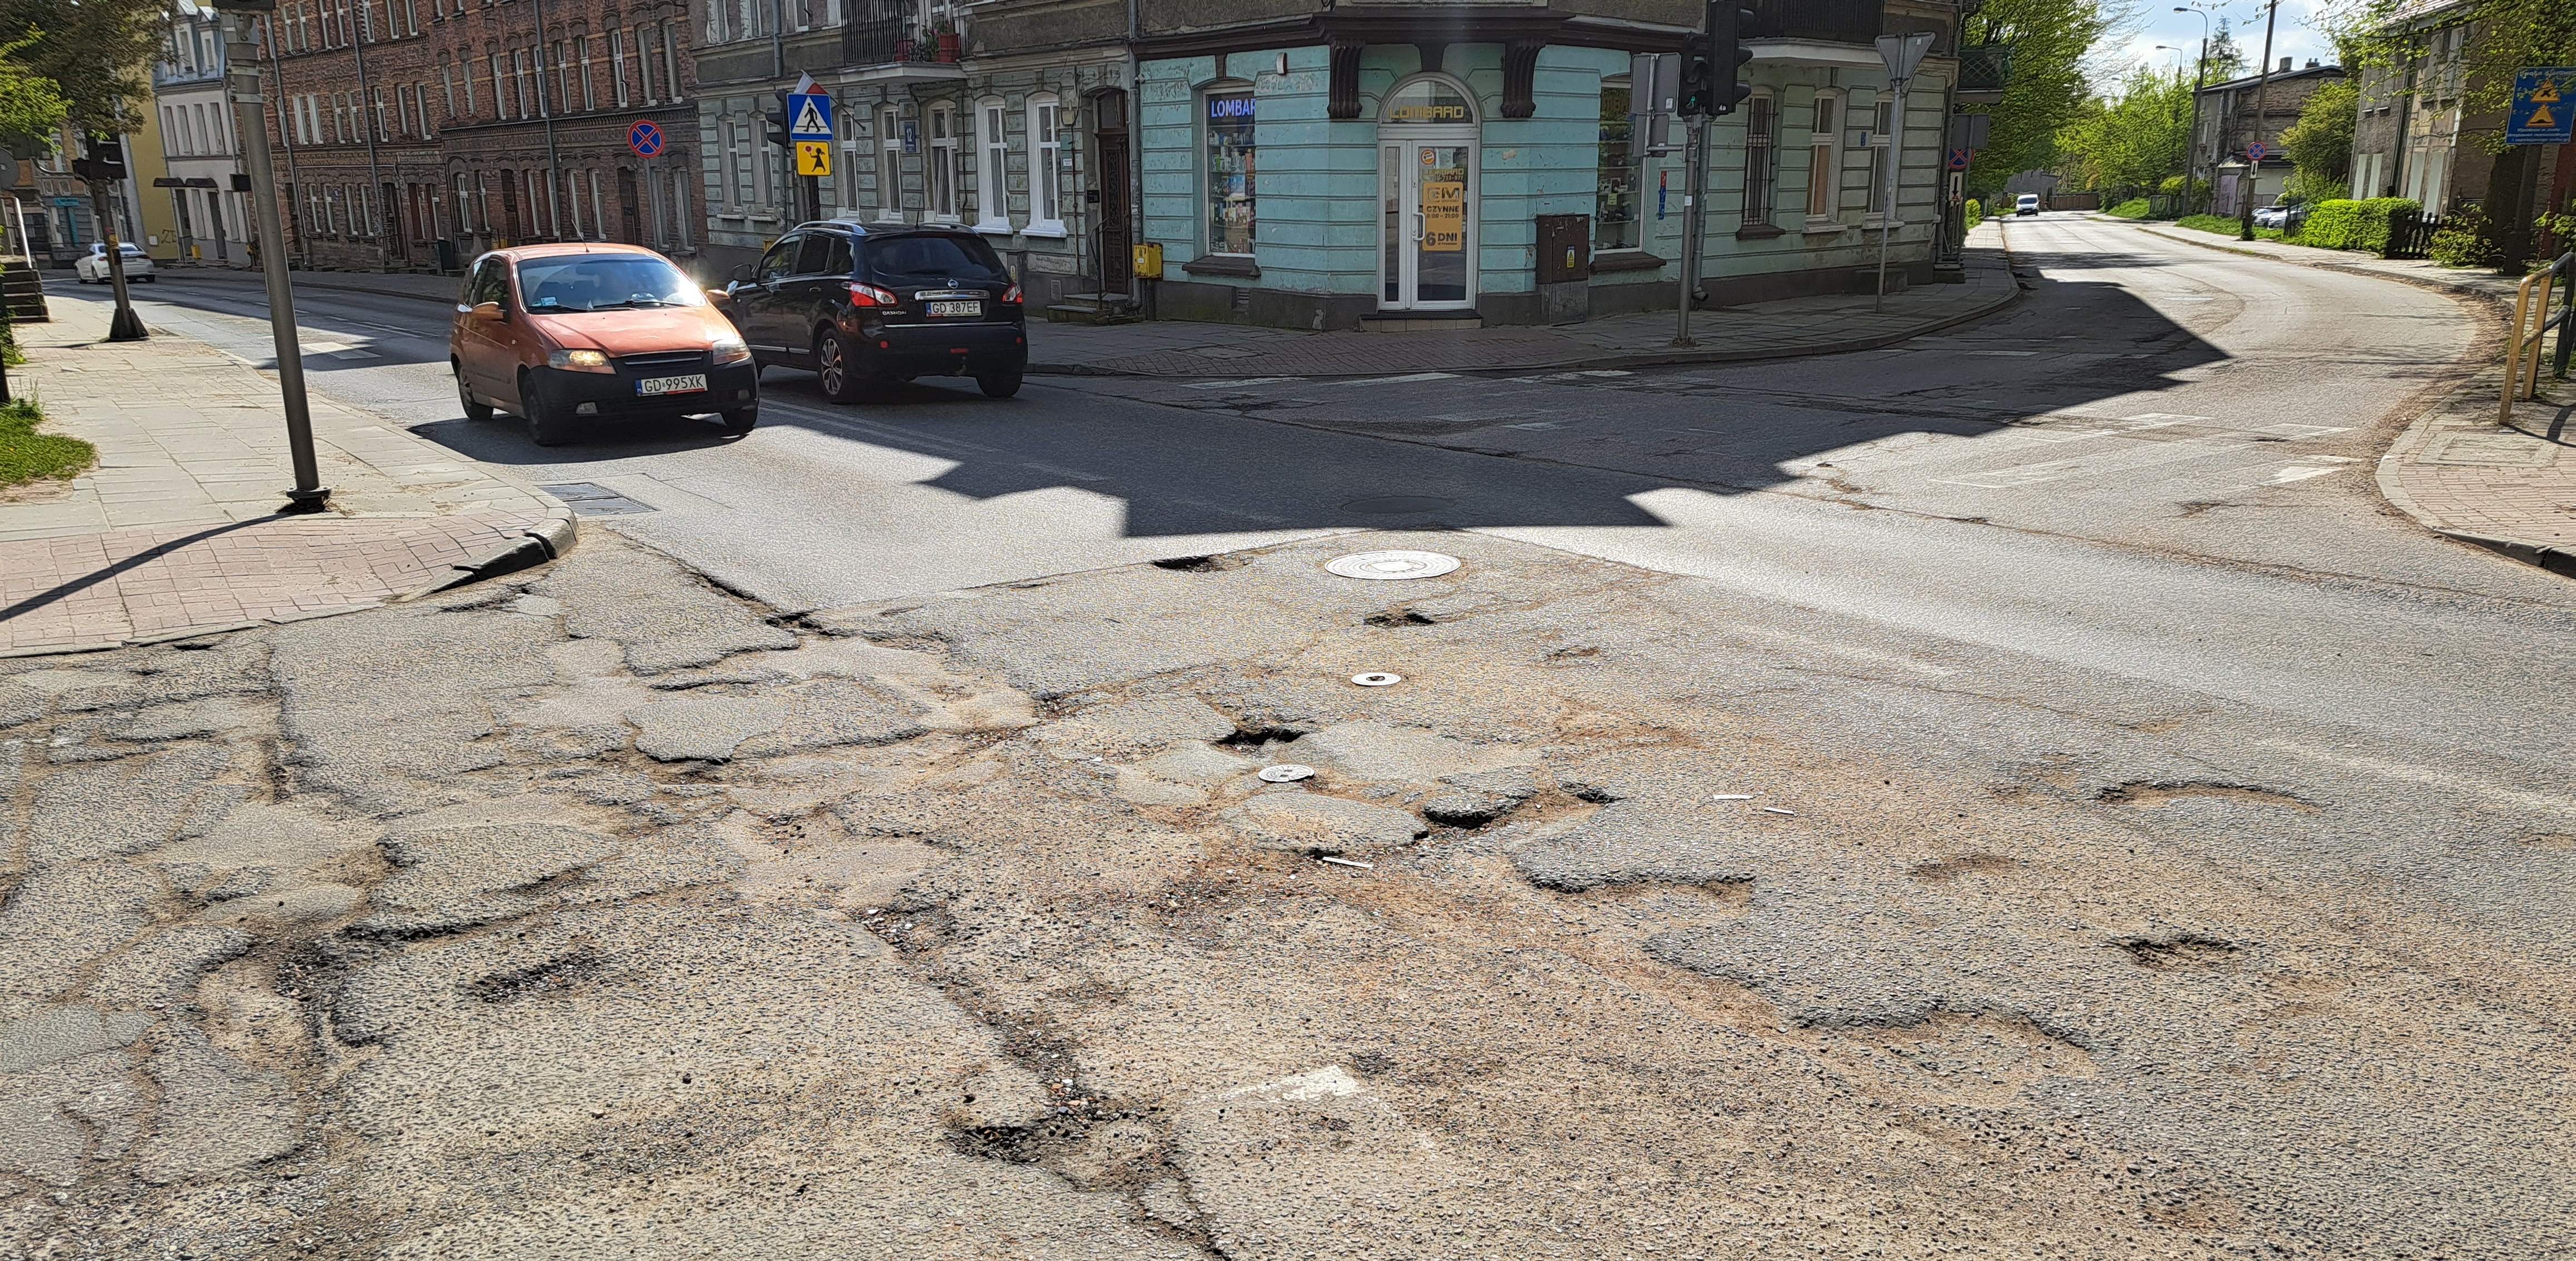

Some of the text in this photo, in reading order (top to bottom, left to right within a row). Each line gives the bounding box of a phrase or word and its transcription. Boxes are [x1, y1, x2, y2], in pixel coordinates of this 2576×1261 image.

[1389, 106, 1465, 119] LOMBARD
[906, 128, 913, 142] 12
[1426, 232, 1457, 246] 6 DNI
[933, 302, 978, 313] GD 387EF
[645, 375, 703, 392] GD 995XK
